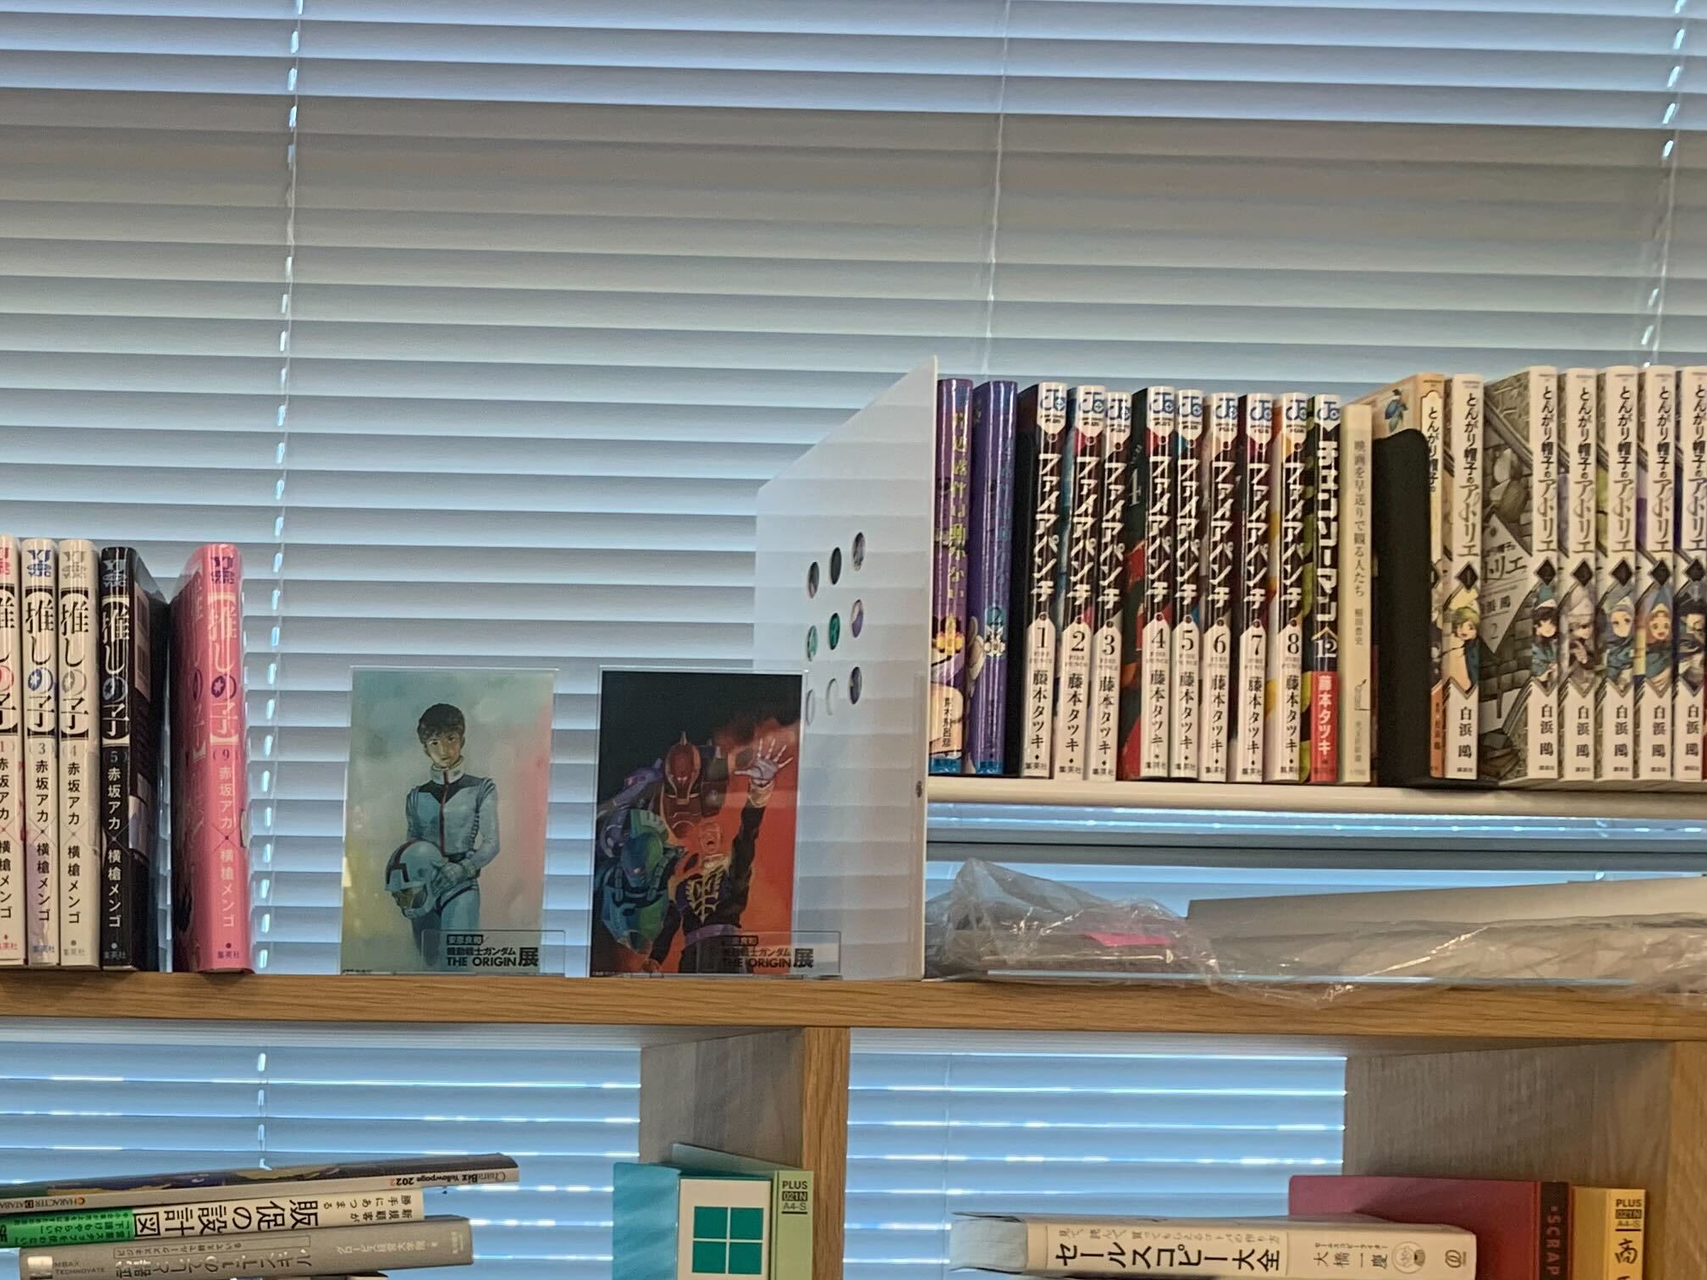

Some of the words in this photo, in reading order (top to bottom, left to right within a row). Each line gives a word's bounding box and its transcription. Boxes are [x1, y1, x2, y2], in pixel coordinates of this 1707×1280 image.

[1457, 392, 1479, 558] とんがり帽子のアトリエ
[1538, 387, 1557, 554] とんがり帽子のアトリエ
[1031, 453, 1061, 602] ファイアパンチ
[1146, 455, 1177, 604] ファイアパンチ
[1315, 640, 1336, 657] 12
[1031, 670, 1048, 751] 藤本タツキ
[1315, 674, 1334, 757] 藤本タツキ
[446, 957, 468, 967] THE
[472, 957, 517, 967] ORIGIN
[518, 947, 539, 967] 展
[135, 1200, 319, 1239] 販促の設計図
[1546, 1216, 1559, 1279] SCRAP
[1056, 1244, 1281, 1273] セールスコピー大全
